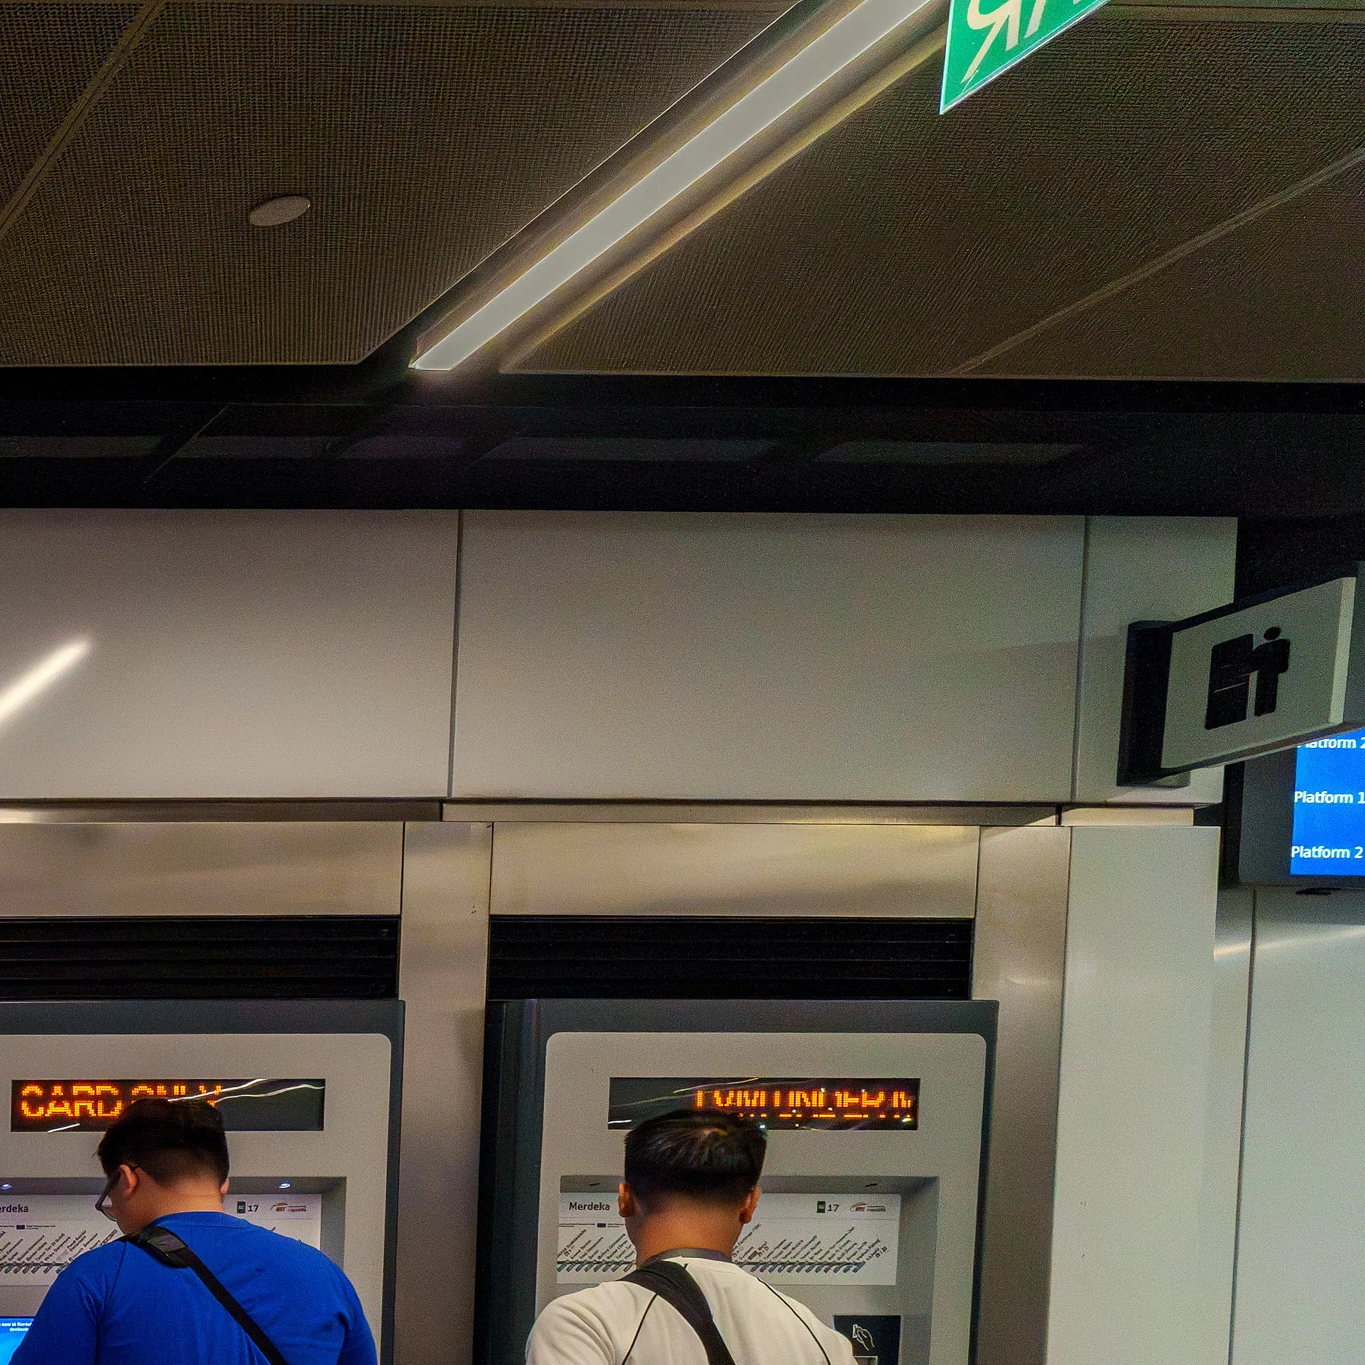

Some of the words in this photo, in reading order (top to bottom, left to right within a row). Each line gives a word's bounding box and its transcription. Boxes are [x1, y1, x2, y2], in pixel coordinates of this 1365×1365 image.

[1297, 737, 1356, 749] atform
[1294, 791, 1353, 804] Platform
[1357, 792, 1365, 804] 1
[1291, 846, 1350, 859] Platform
[1354, 846, 1363, 859] 2
[21, 1085, 122, 1117] CARD
[247, 1204, 260, 1213] 17
[568, 1201, 611, 1211] Merdeka
[827, 1204, 840, 1213] 17
